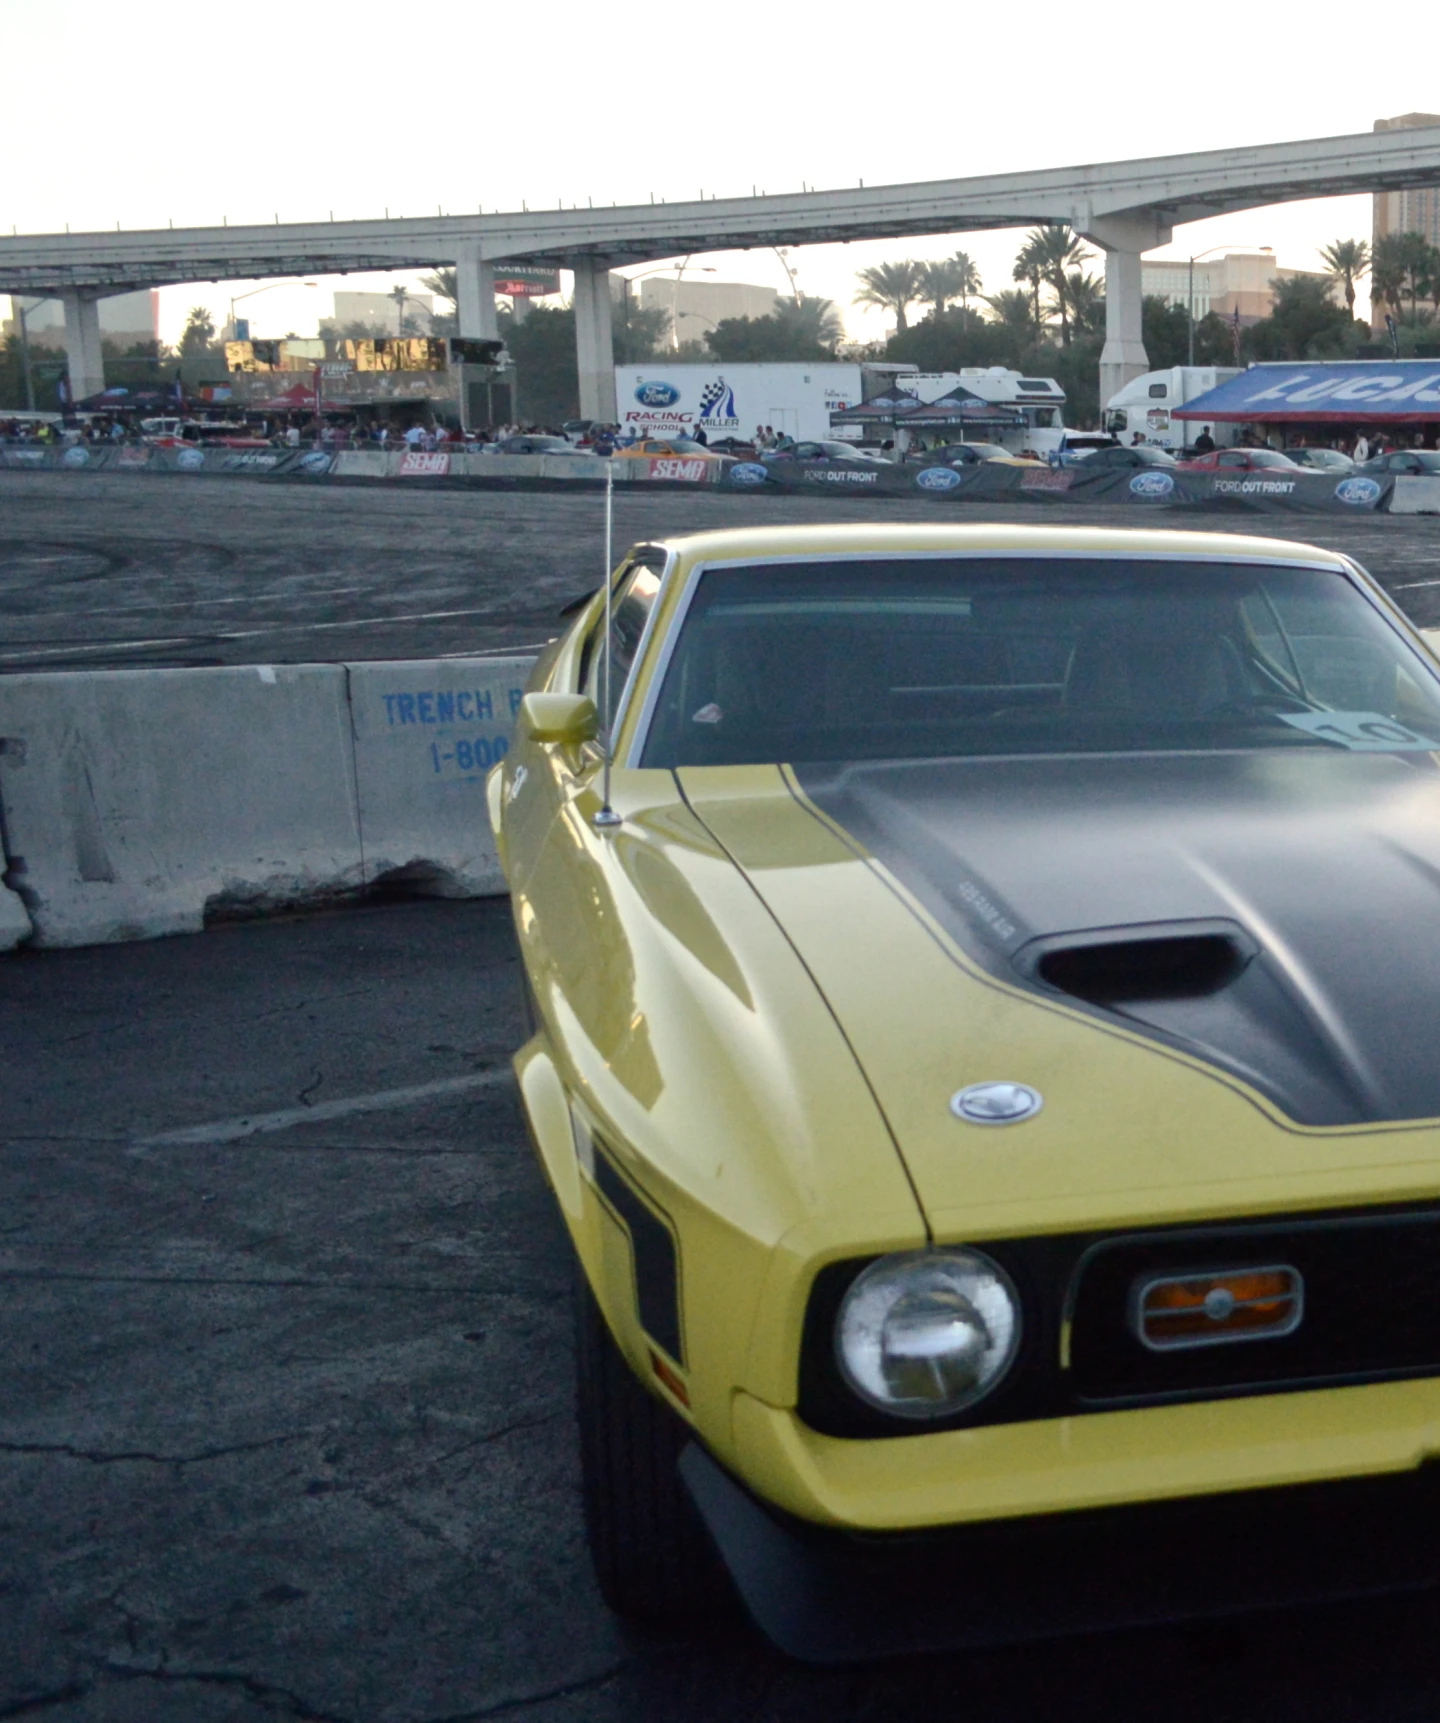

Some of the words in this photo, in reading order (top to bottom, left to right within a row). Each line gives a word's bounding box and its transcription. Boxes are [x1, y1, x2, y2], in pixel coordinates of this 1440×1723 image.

[625, 411, 694, 423] RACING
[700, 418, 739, 427] MILLER
[639, 424, 682, 432] SCHOOL
[403, 453, 448, 471] SEMA
[804, 470, 827, 482] FORD
[847, 471, 878, 483] FRONT
[1214, 480, 1242, 493] FORD
[1242, 481, 1263, 493] OUT
[1263, 482, 1296, 494] FRONT
[382, 689, 494, 726] TRENCH
